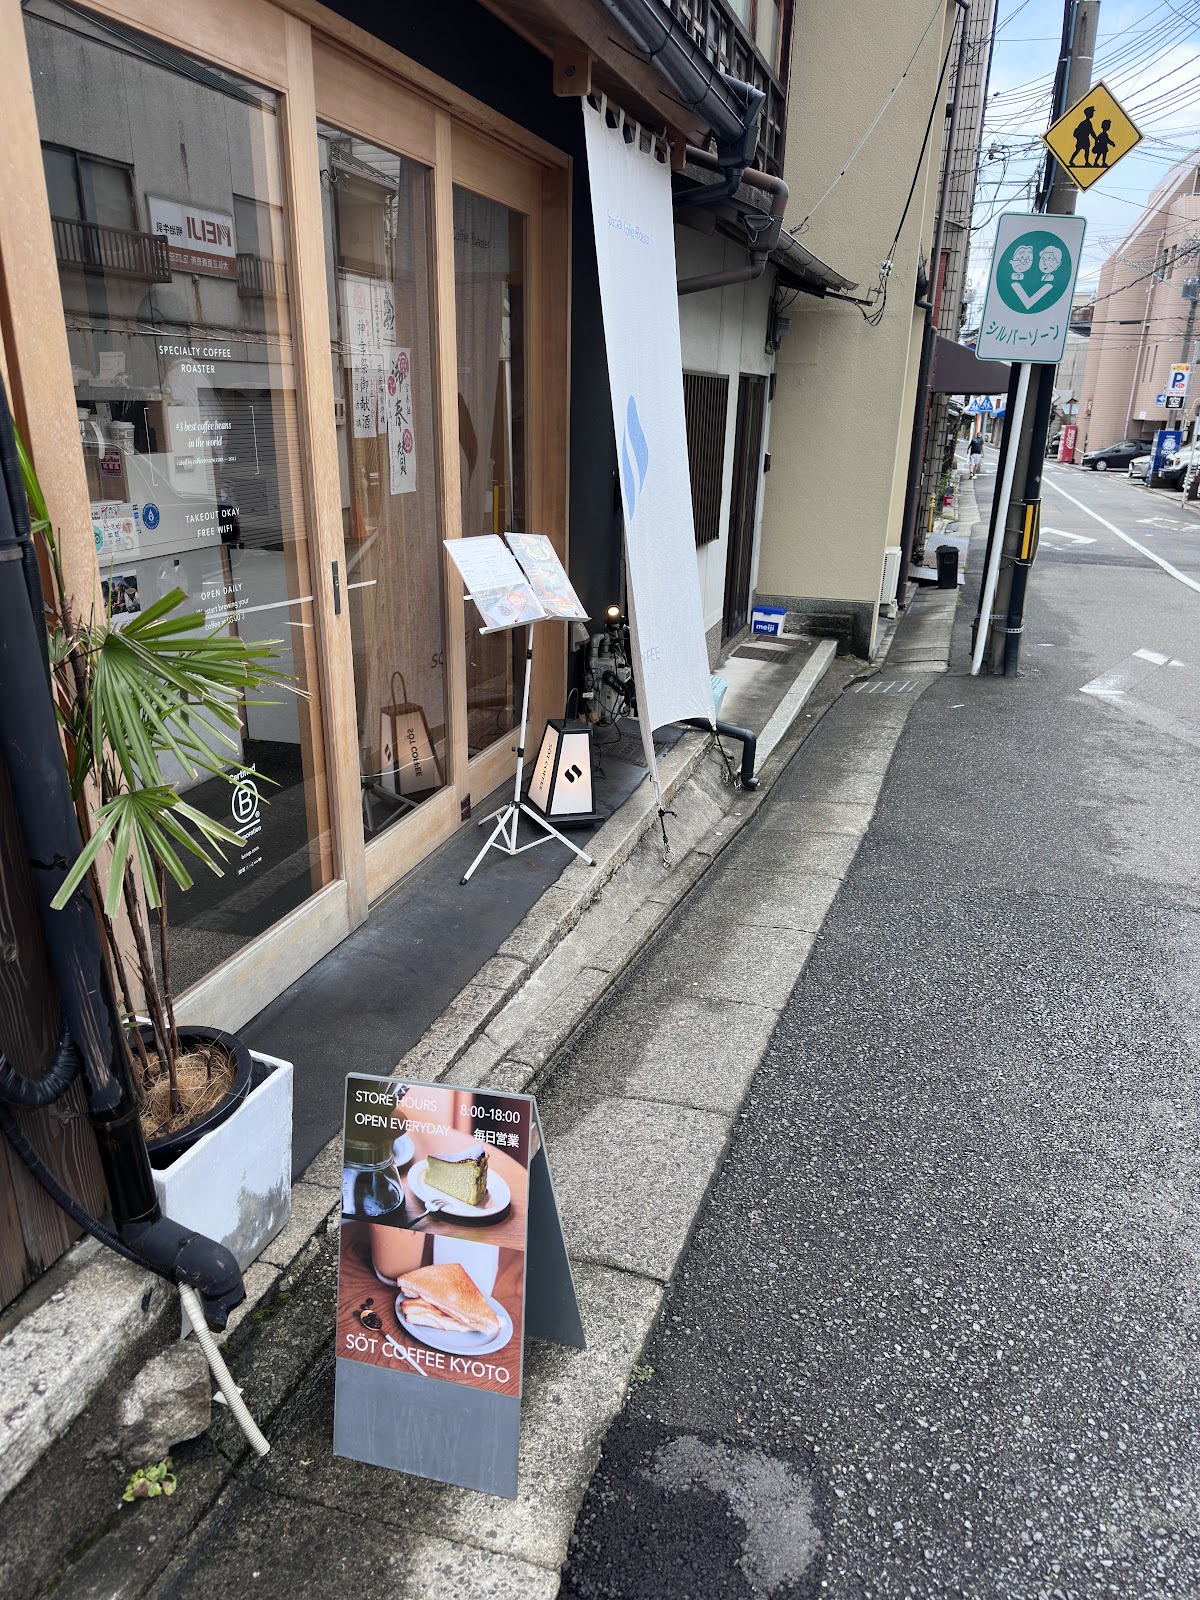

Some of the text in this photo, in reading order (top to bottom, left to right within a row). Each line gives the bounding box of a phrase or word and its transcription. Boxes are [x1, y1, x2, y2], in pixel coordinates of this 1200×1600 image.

[985, 321, 1059, 346] シルバーゾーン
[158, 345, 232, 358] SPECIALTY COFFEE
[181, 363, 216, 374] ROASTER
[1171, 372, 1186, 389] P
[184, 420, 197, 431] best
[197, 420, 215, 434] coffee
[214, 419, 232, 430] beans
[188, 435, 223, 448] in the world
[185, 507, 241, 524] TAKEOUT OKAY
[197, 524, 233, 538] FREE WIFI
[200, 583, 243, 601] OPEN DAILY
[217, 600, 239, 612] brewing
[238, 597, 250, 609] your
[204, 620, 221, 631] coffee
[755, 622, 775, 633] meiji
[355, 1090, 521, 1124] STORE HOURS 8:00-18:00
[354, 1112, 451, 1137] OPEN EVERYDAY
[473, 1128, 520, 1149] 毎日営業
[345, 1332, 511, 1384] SÖT COFFEE KYOTO
